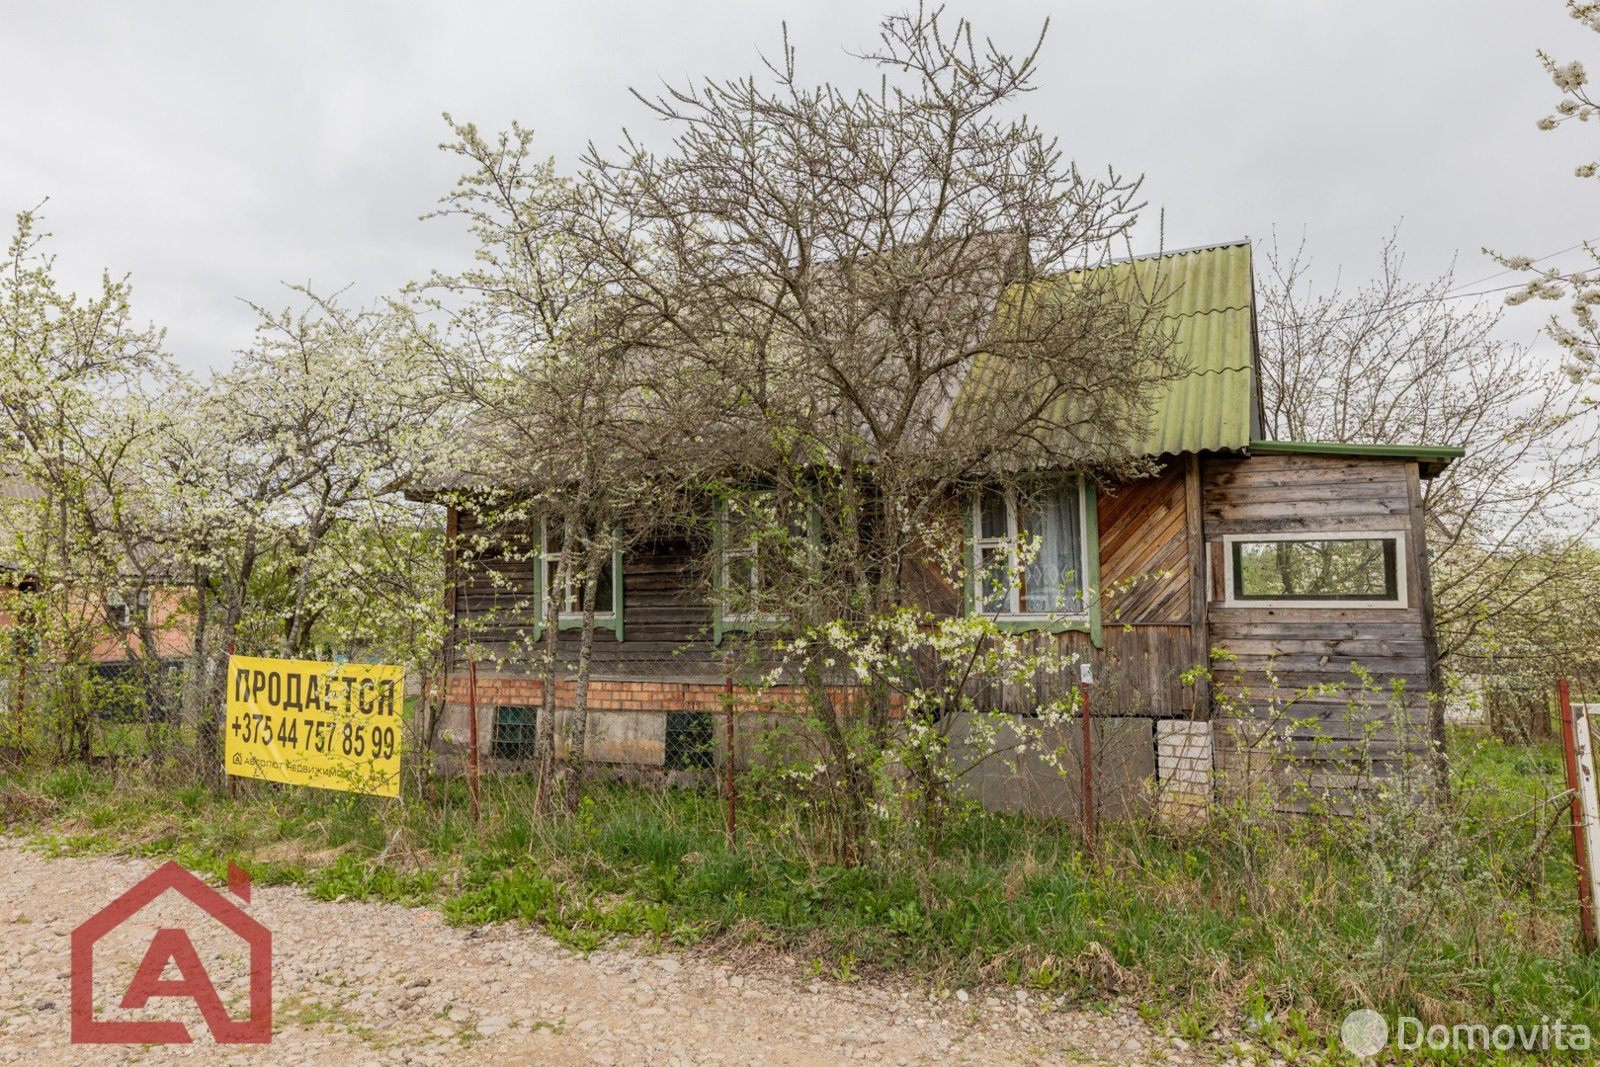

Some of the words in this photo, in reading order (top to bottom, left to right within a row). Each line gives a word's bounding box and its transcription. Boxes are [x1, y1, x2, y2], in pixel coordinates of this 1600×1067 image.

[235, 668, 394, 716] ПРОДАЕТСЯ
[232, 712, 273, 746] +375
[277, 717, 298, 749] 44
[304, 719, 336, 753] 757
[342, 722, 366, 756] 85
[371, 725, 394, 760] 99
